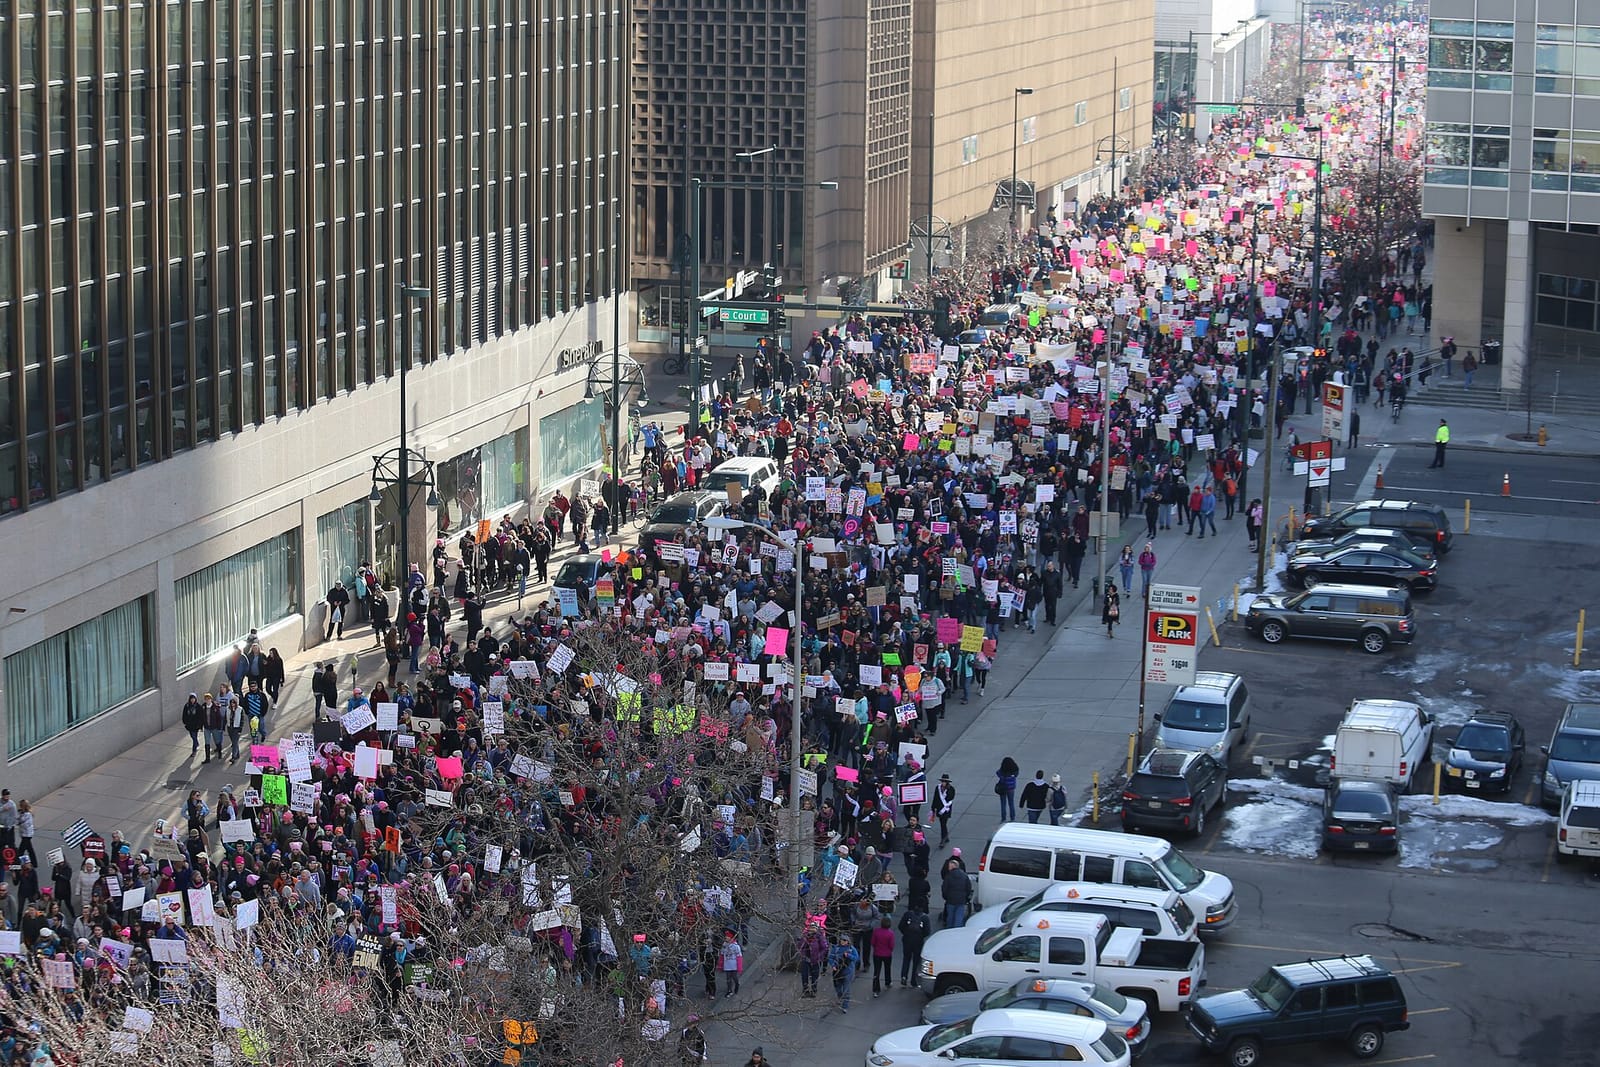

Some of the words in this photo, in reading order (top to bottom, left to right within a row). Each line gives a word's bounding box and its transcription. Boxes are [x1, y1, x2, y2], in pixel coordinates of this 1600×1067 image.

[733, 311, 757, 321] Court
[563, 340, 604, 368] Sheraton
[1161, 616, 1192, 640] PARK
[900, 712, 917, 721] LOVE
[362, 934, 379, 943] ALL
[356, 939, 383, 951] PEOPLE
